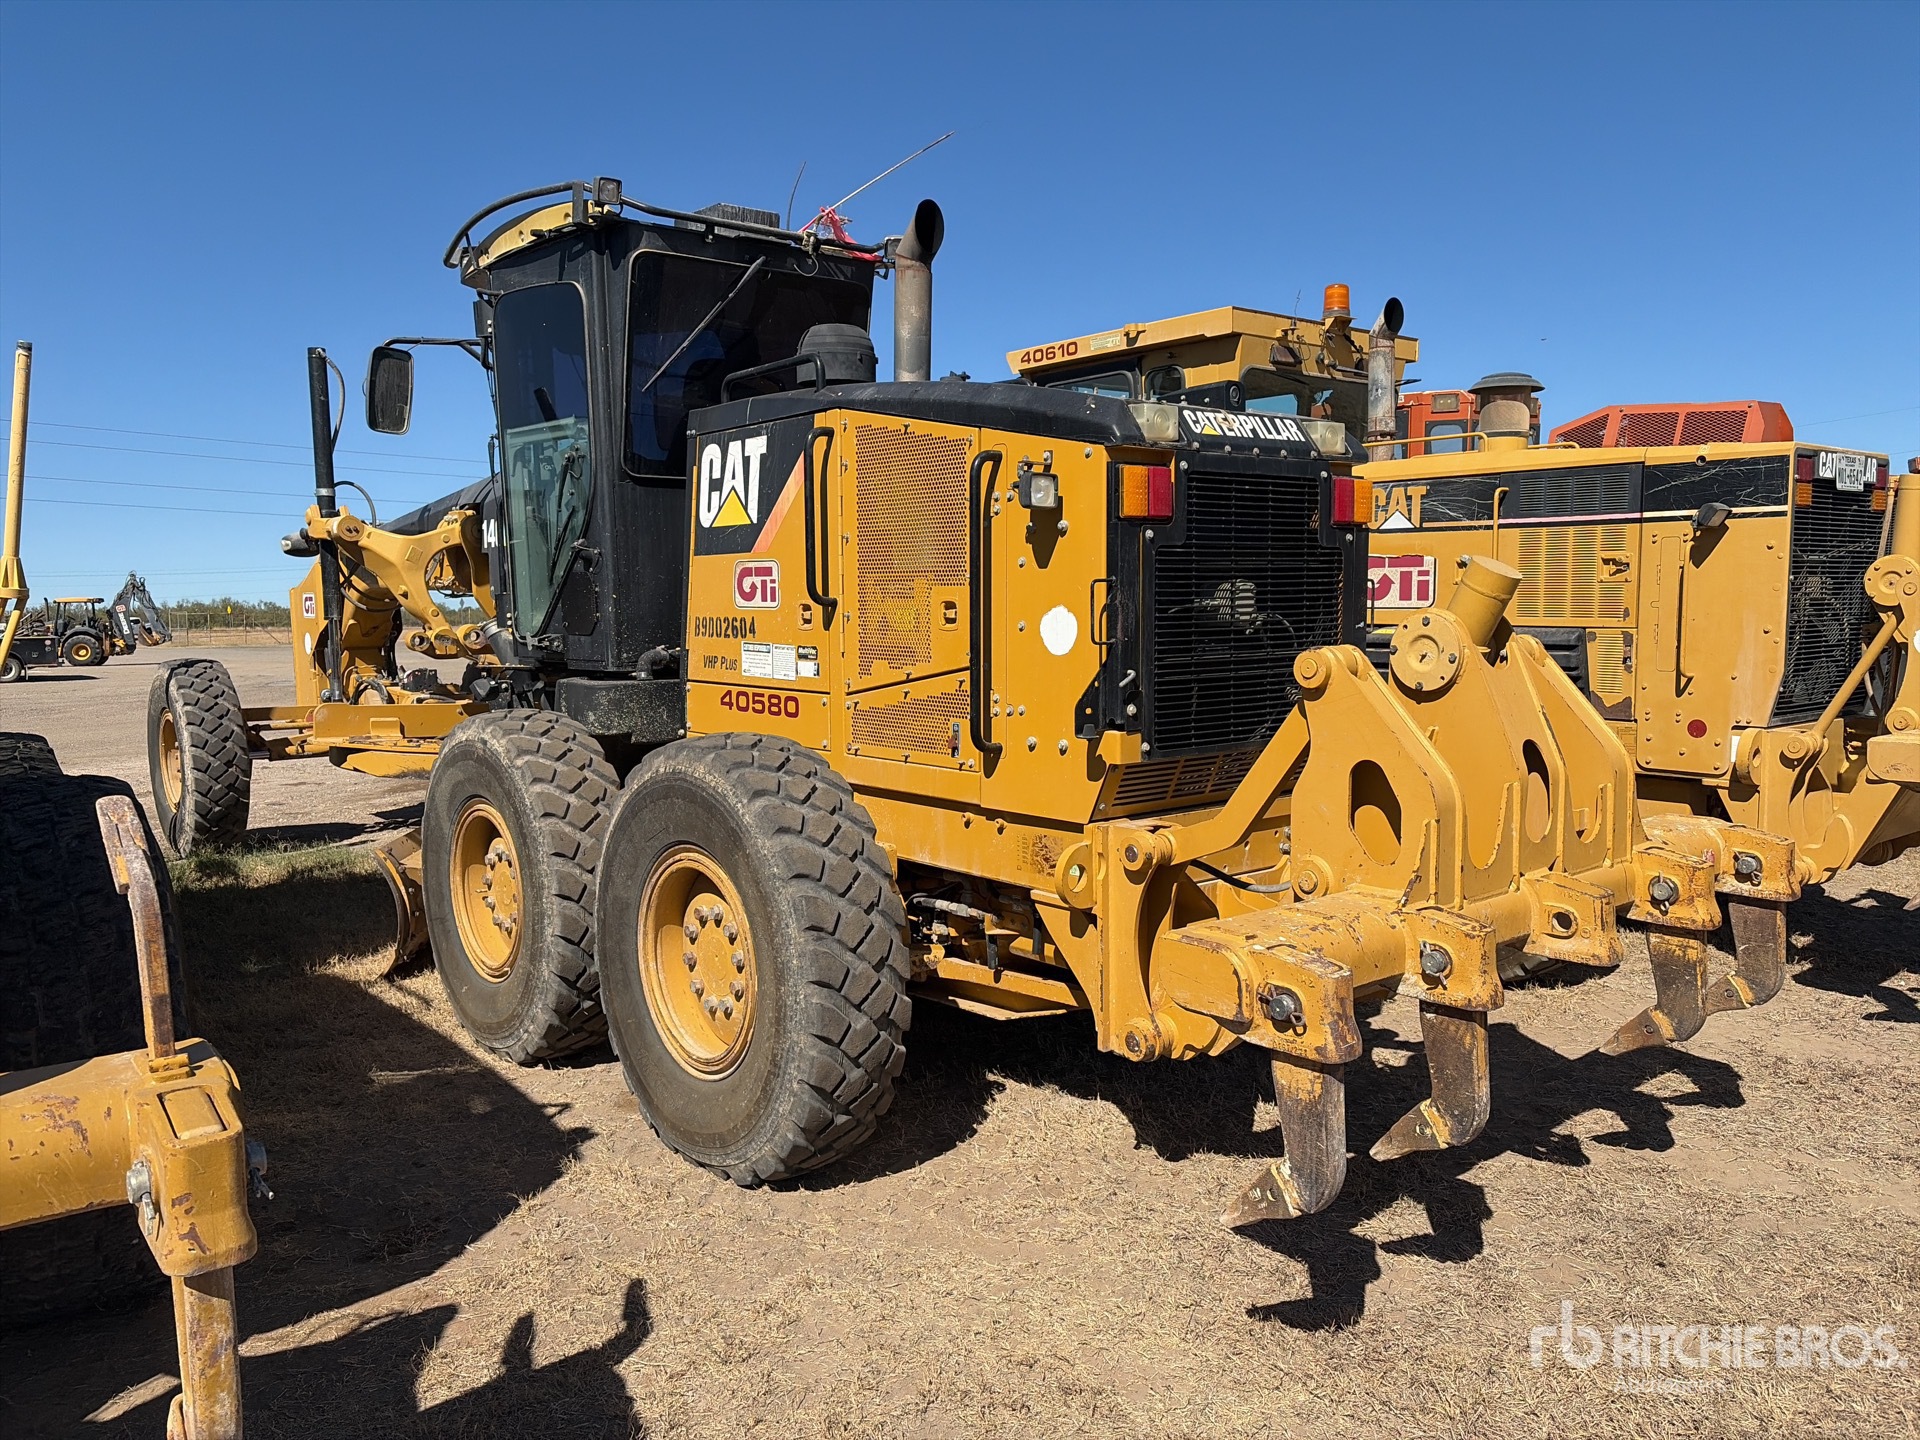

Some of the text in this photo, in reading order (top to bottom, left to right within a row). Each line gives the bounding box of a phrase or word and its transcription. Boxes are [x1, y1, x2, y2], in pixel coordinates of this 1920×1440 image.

[1020, 341, 1078, 364] 40610
[1182, 409, 1305, 442] CATERPILLAR
[699, 435, 768, 529] CAT
[1368, 485, 1427, 530] CAT
[703, 654, 719, 670] VHP
[720, 689, 800, 719] 40580
